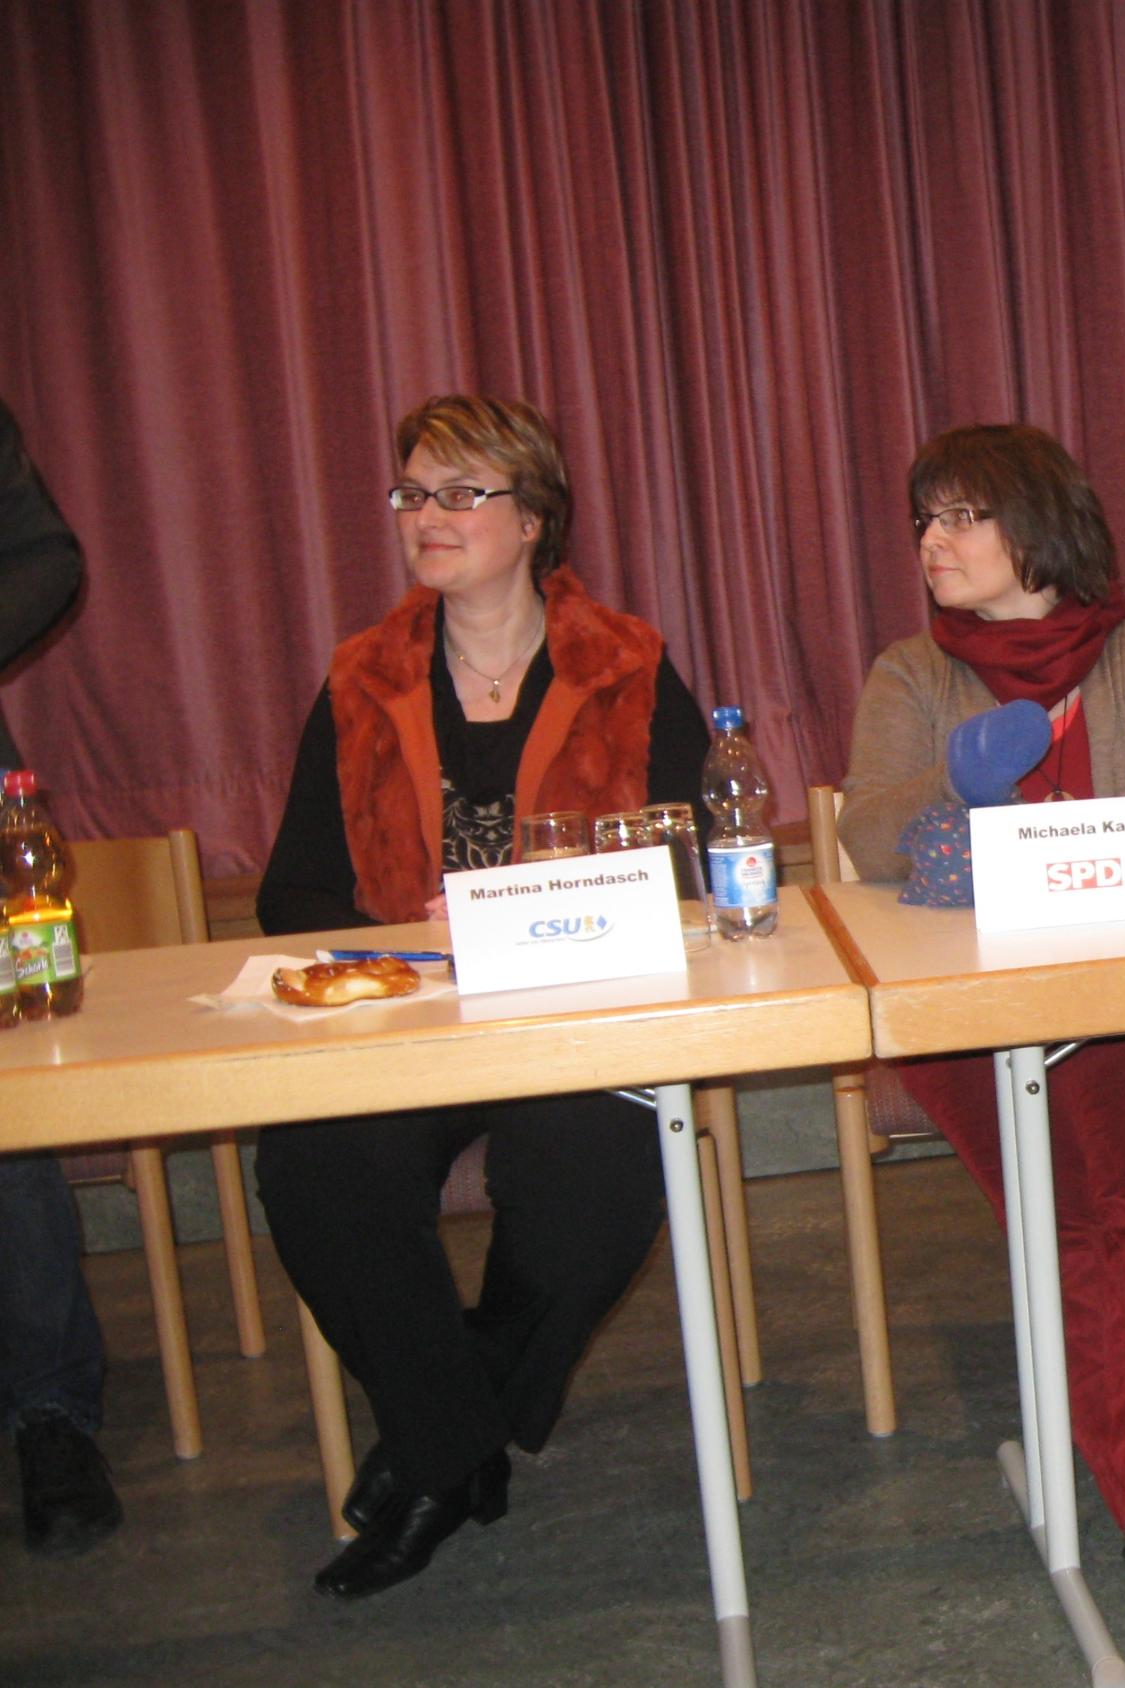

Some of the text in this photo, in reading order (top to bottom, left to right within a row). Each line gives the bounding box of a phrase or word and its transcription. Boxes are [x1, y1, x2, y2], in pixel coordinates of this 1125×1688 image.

[1018, 823, 1097, 840] Michaela
[469, 869, 649, 901] Martina Horndasch
[1047, 858, 1122, 891] SPD
[529, 918, 581, 938] CSU
